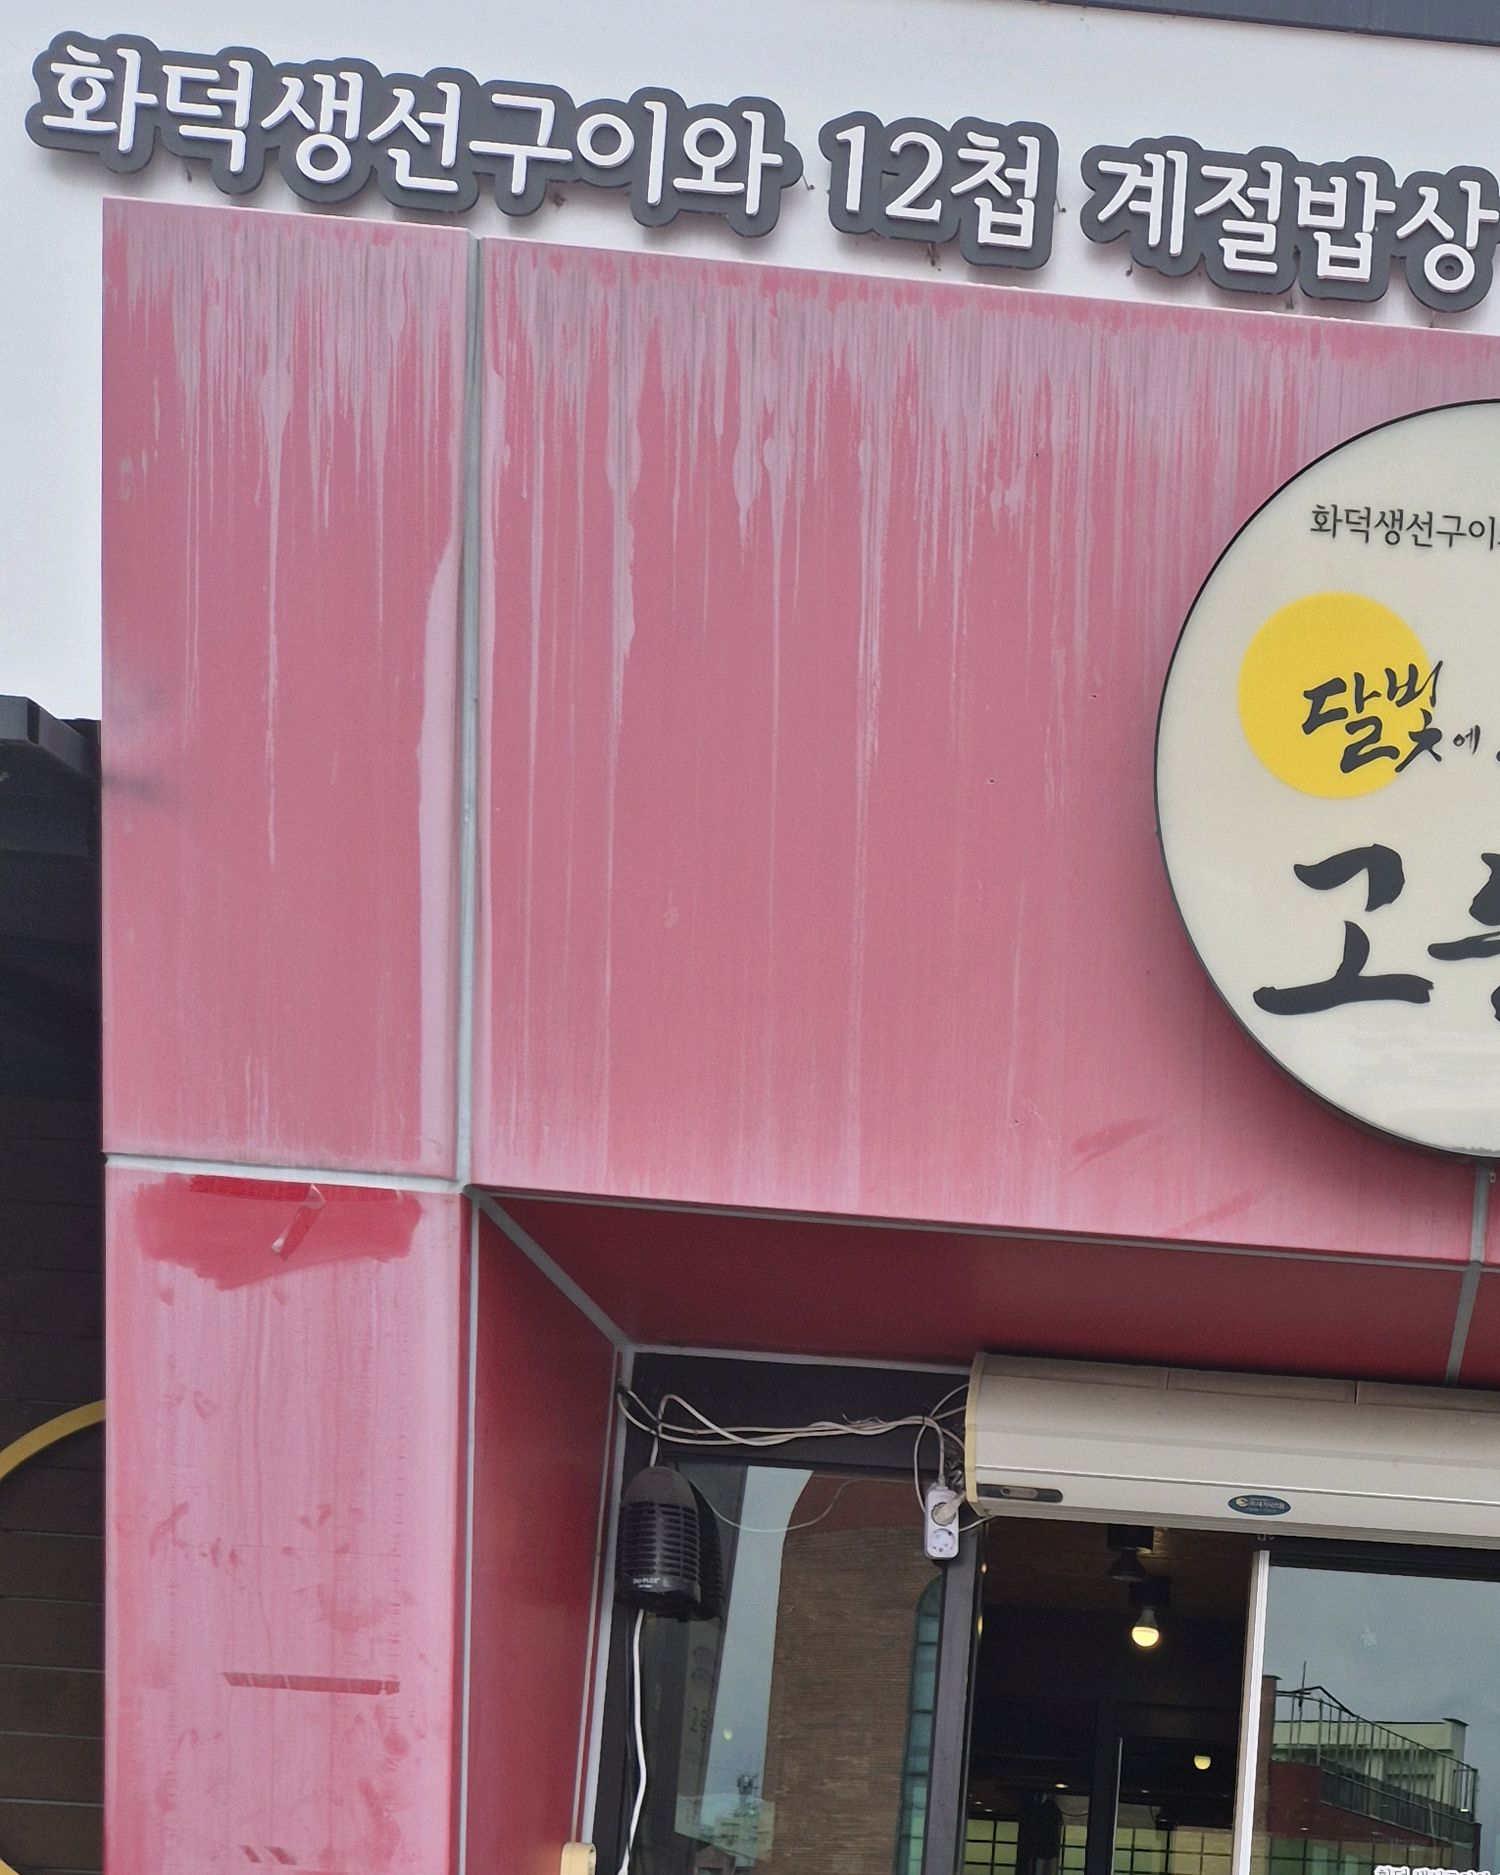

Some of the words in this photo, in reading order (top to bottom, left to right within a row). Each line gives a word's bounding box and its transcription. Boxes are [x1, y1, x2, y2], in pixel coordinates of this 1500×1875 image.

[42, 44, 783, 217] 화덕생선구이와
[835, 125, 1041, 249] 12첩
[1099, 150, 1499, 293] 계절밥상
[1302, 661, 1480, 773] 달빛에
